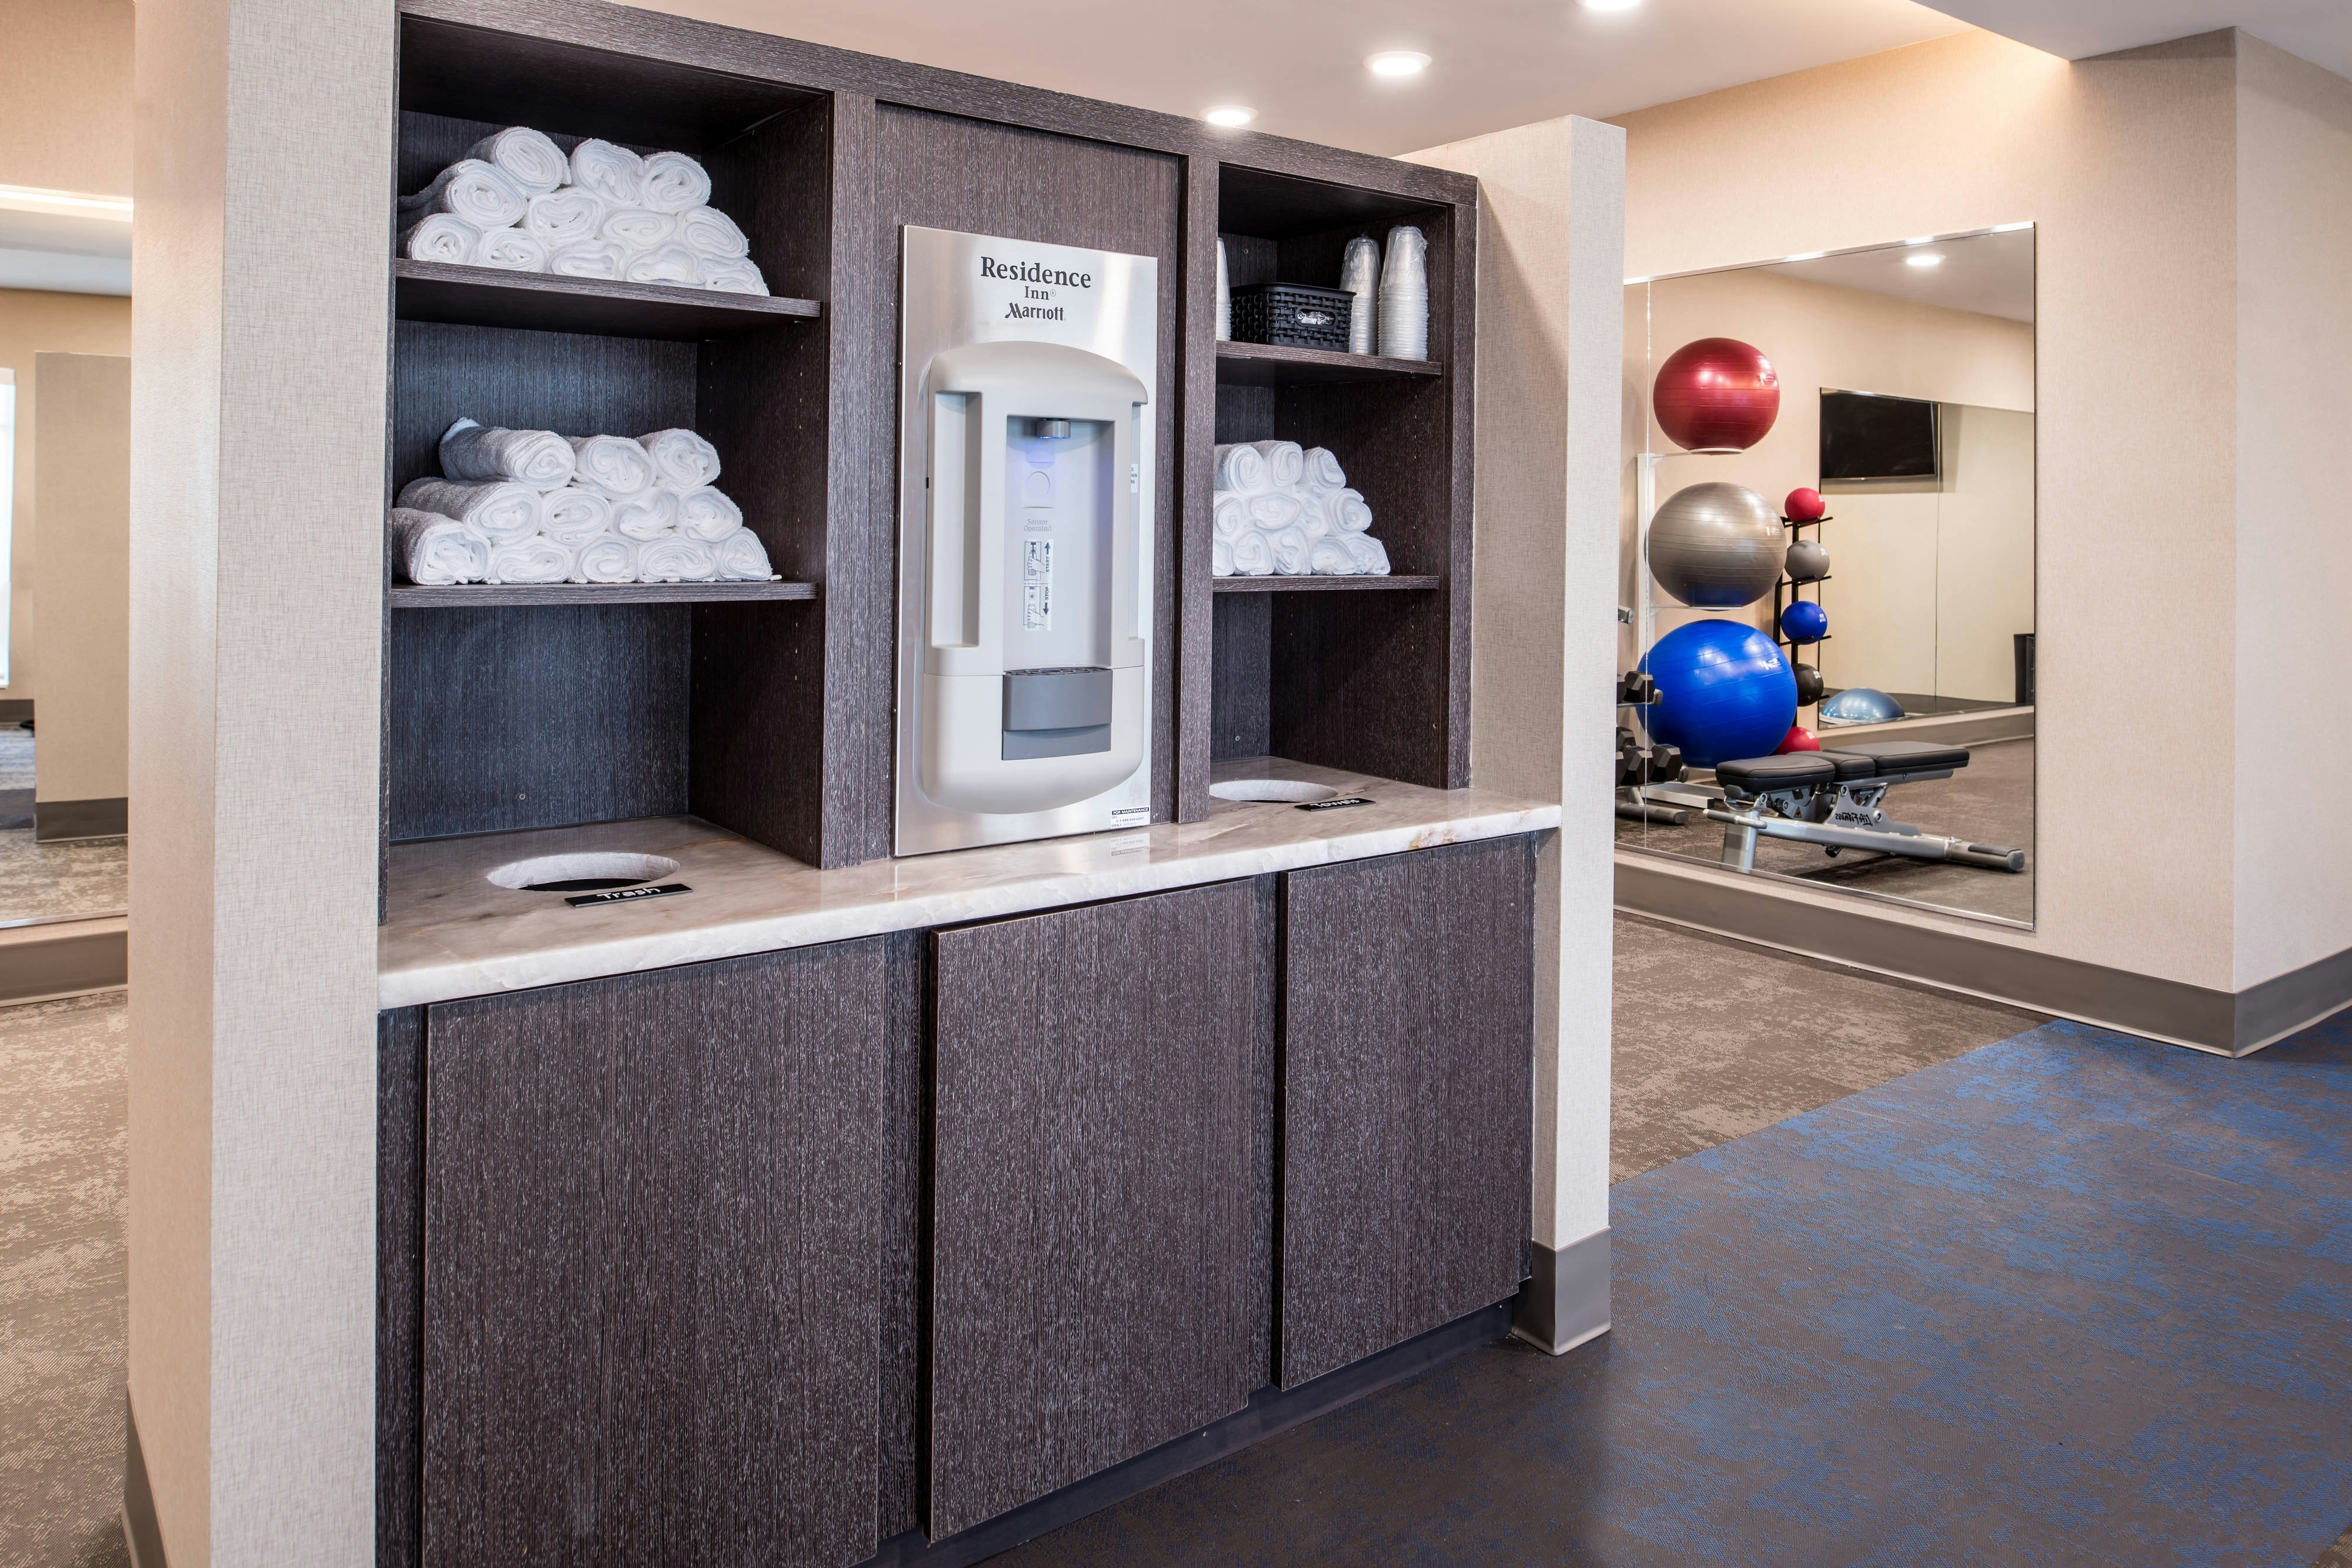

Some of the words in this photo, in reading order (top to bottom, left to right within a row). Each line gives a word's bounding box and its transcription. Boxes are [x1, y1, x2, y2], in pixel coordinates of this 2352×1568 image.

[981, 256, 1091, 289] Residence
[1005, 302, 1064, 321] Marriott
[1024, 524, 1052, 533] Operated
[596, 888, 660, 899] Trash
